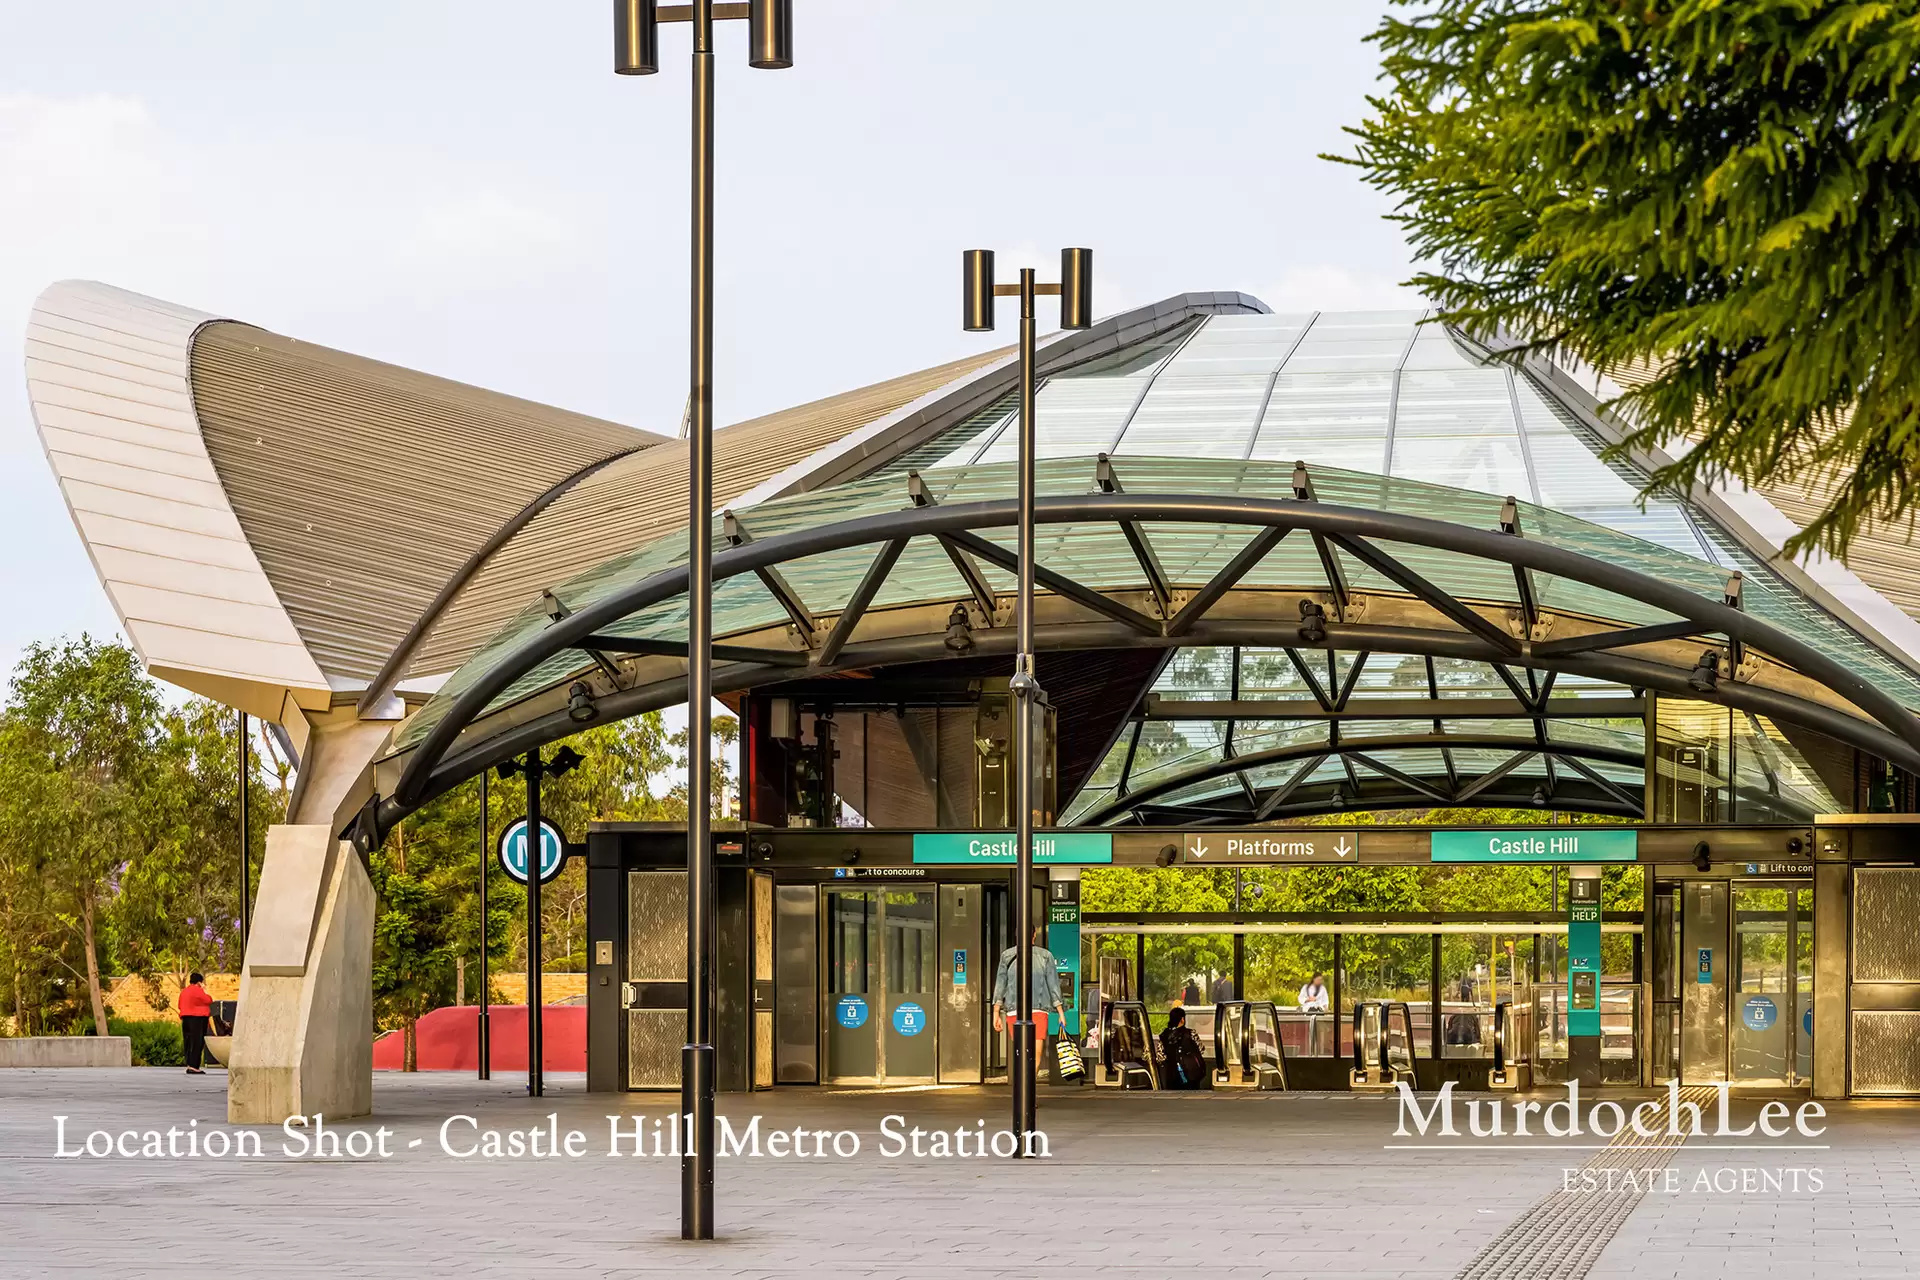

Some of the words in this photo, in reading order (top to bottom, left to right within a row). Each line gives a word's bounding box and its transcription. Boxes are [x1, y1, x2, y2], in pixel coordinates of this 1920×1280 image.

[1227, 838, 1315, 856] Platforms
[1489, 837, 1545, 854] Castle
[1550, 837, 1578, 854] Hill
[873, 868, 882, 876] to
[883, 868, 925, 876] concourse
[1770, 863, 1786, 872] Lift
[1787, 864, 1796, 872] to
[1052, 913, 1077, 922] HELP
[1572, 911, 1598, 921] HELP
